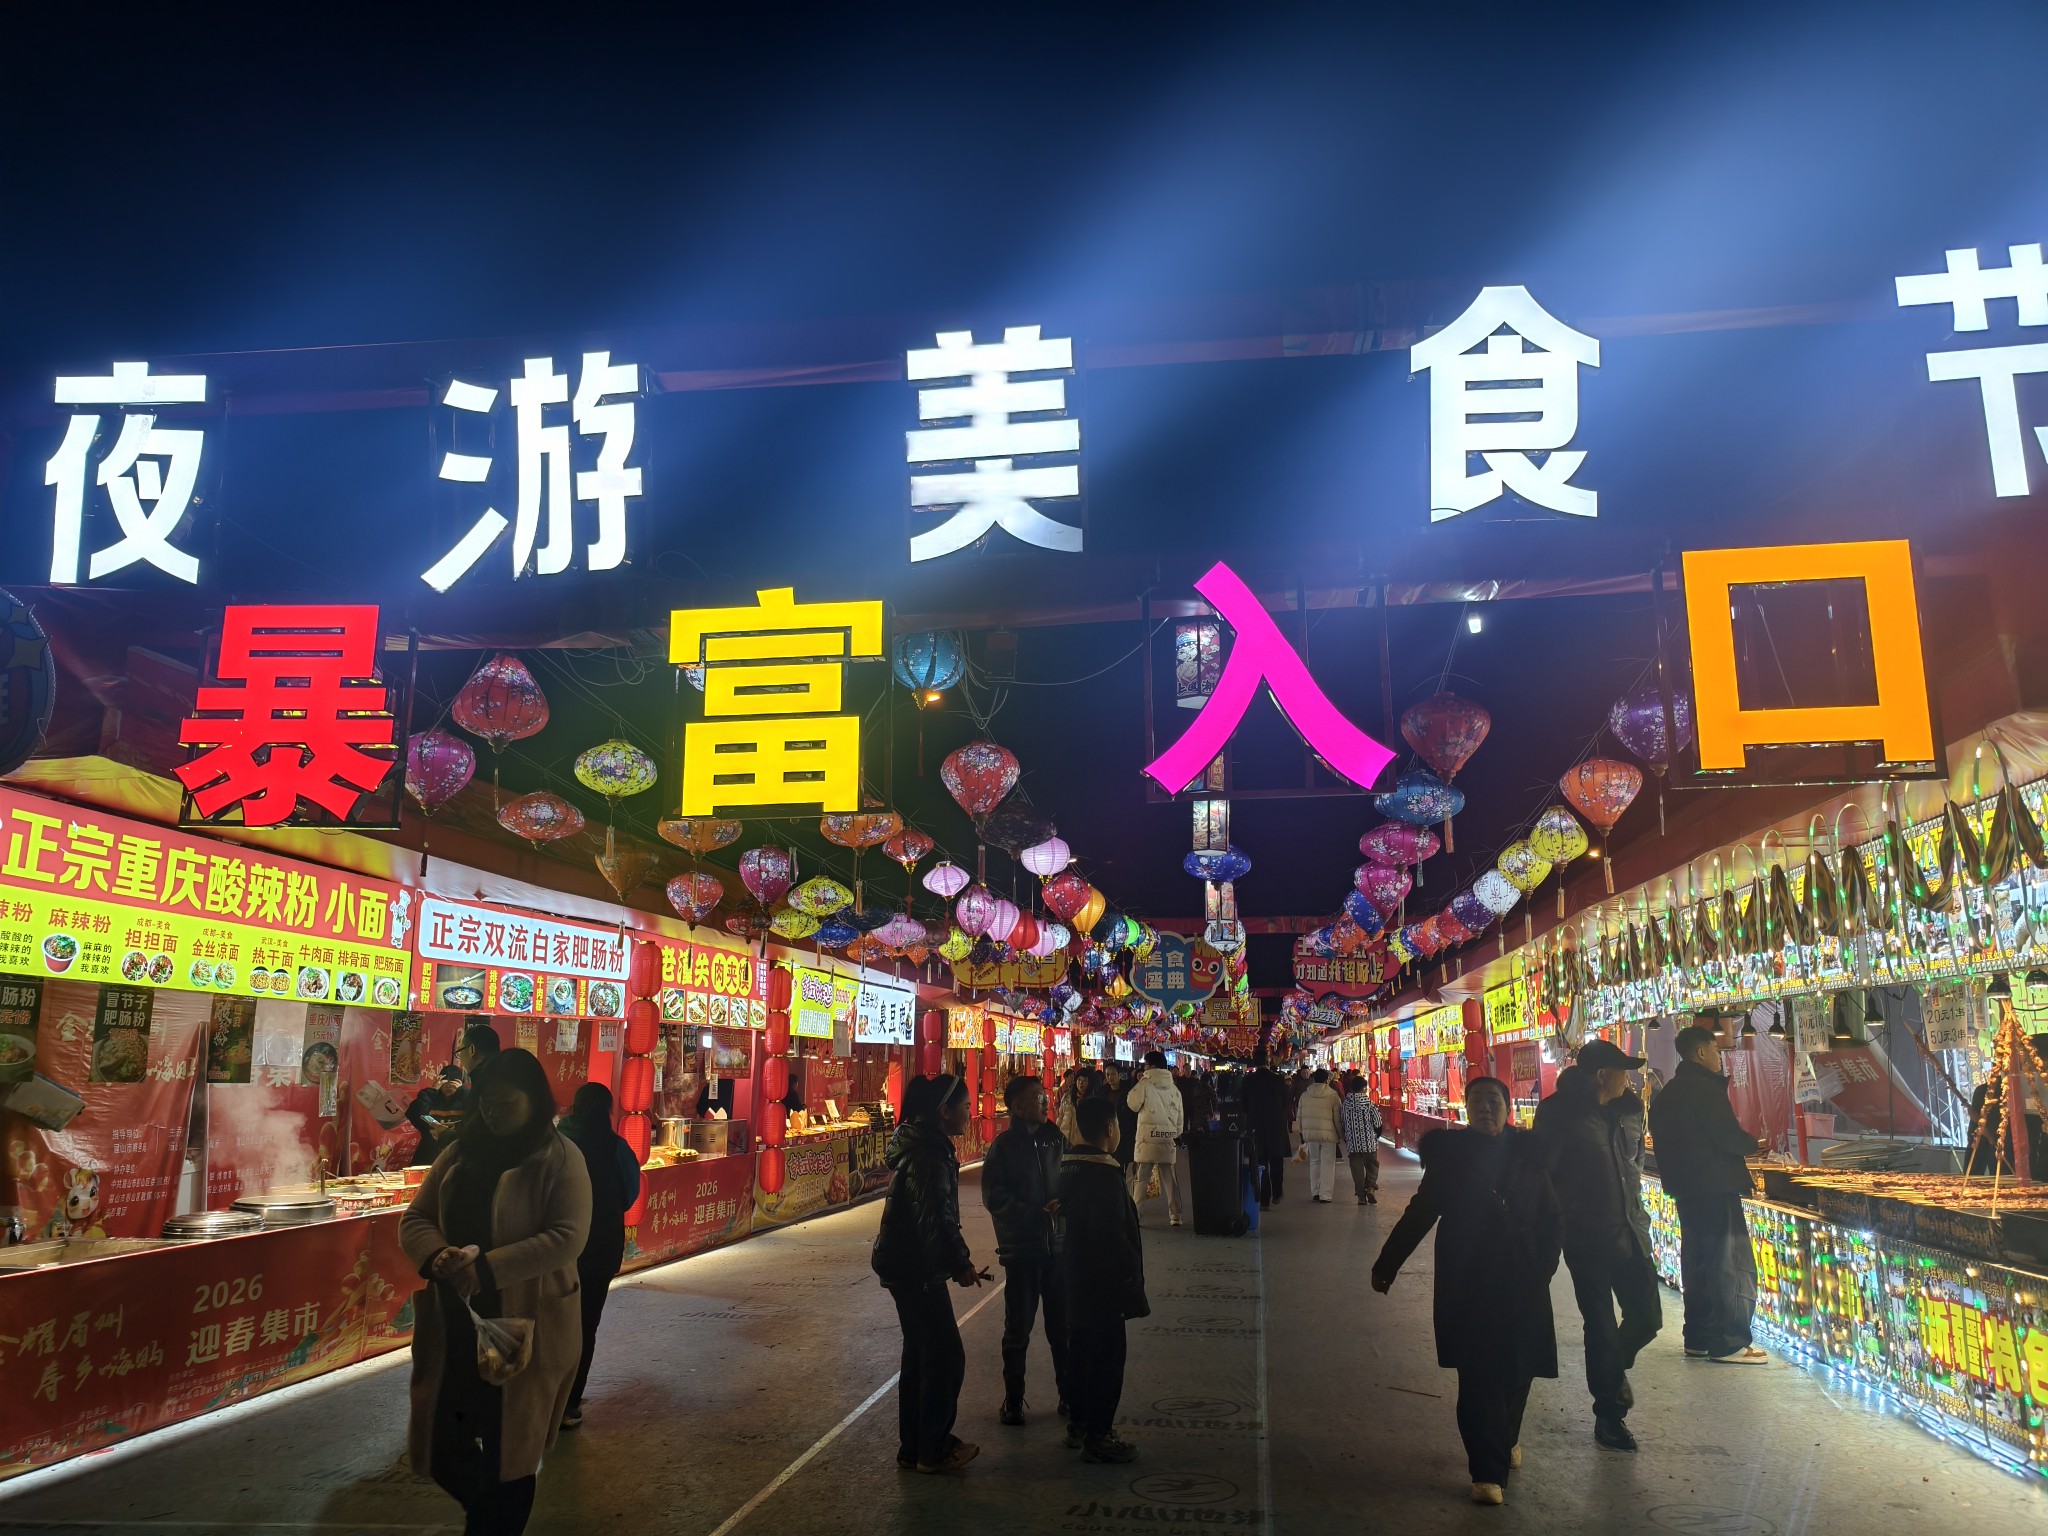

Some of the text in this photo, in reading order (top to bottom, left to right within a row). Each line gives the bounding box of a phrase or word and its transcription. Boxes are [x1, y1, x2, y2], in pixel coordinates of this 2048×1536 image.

[45, 244, 2048, 592] 夜游美食节
[177, 541, 1936, 827] 暴富入口
[2, 808, 390, 940] 正宗重庆酸辣粉 小面
[48, 908, 111, 934] 麻辣粉
[0, 930, 33, 944] 酸酸的
[83, 942, 112, 954] 麻麻的
[125, 928, 178, 954] 担担面
[192, 939, 240, 961] 金丝凉面
[252, 947, 294, 968] 热干面
[299, 944, 334, 964] 牛肉面
[338, 950, 371, 969] 排骨面
[81, 963, 109, 975] 我喜欢
[373, 955, 404, 974] 肥肠面
[420, 962, 432, 1004] 肥肠粉
[488, 969, 498, 1008] 排骨粉
[1145, 971, 1185, 990] 盛典
[0, 986, 36, 1007] 肠粉
[106, 992, 148, 1009] 冒节子
[535, 975, 544, 1012] 牛肉粉
[103, 1009, 146, 1027] 肥肠粉
[1927, 1007, 1966, 1024] 20元1串
[855, 1131, 890, 1170] 长沙臭
[695, 1180, 718, 1199] 2026
[693, 1198, 737, 1226] 迎春集市
[192, 1274, 264, 1314] 2026
[185, 1301, 321, 1367] 迎春集市
[1918, 1296, 2048, 1407] 新疆特色
